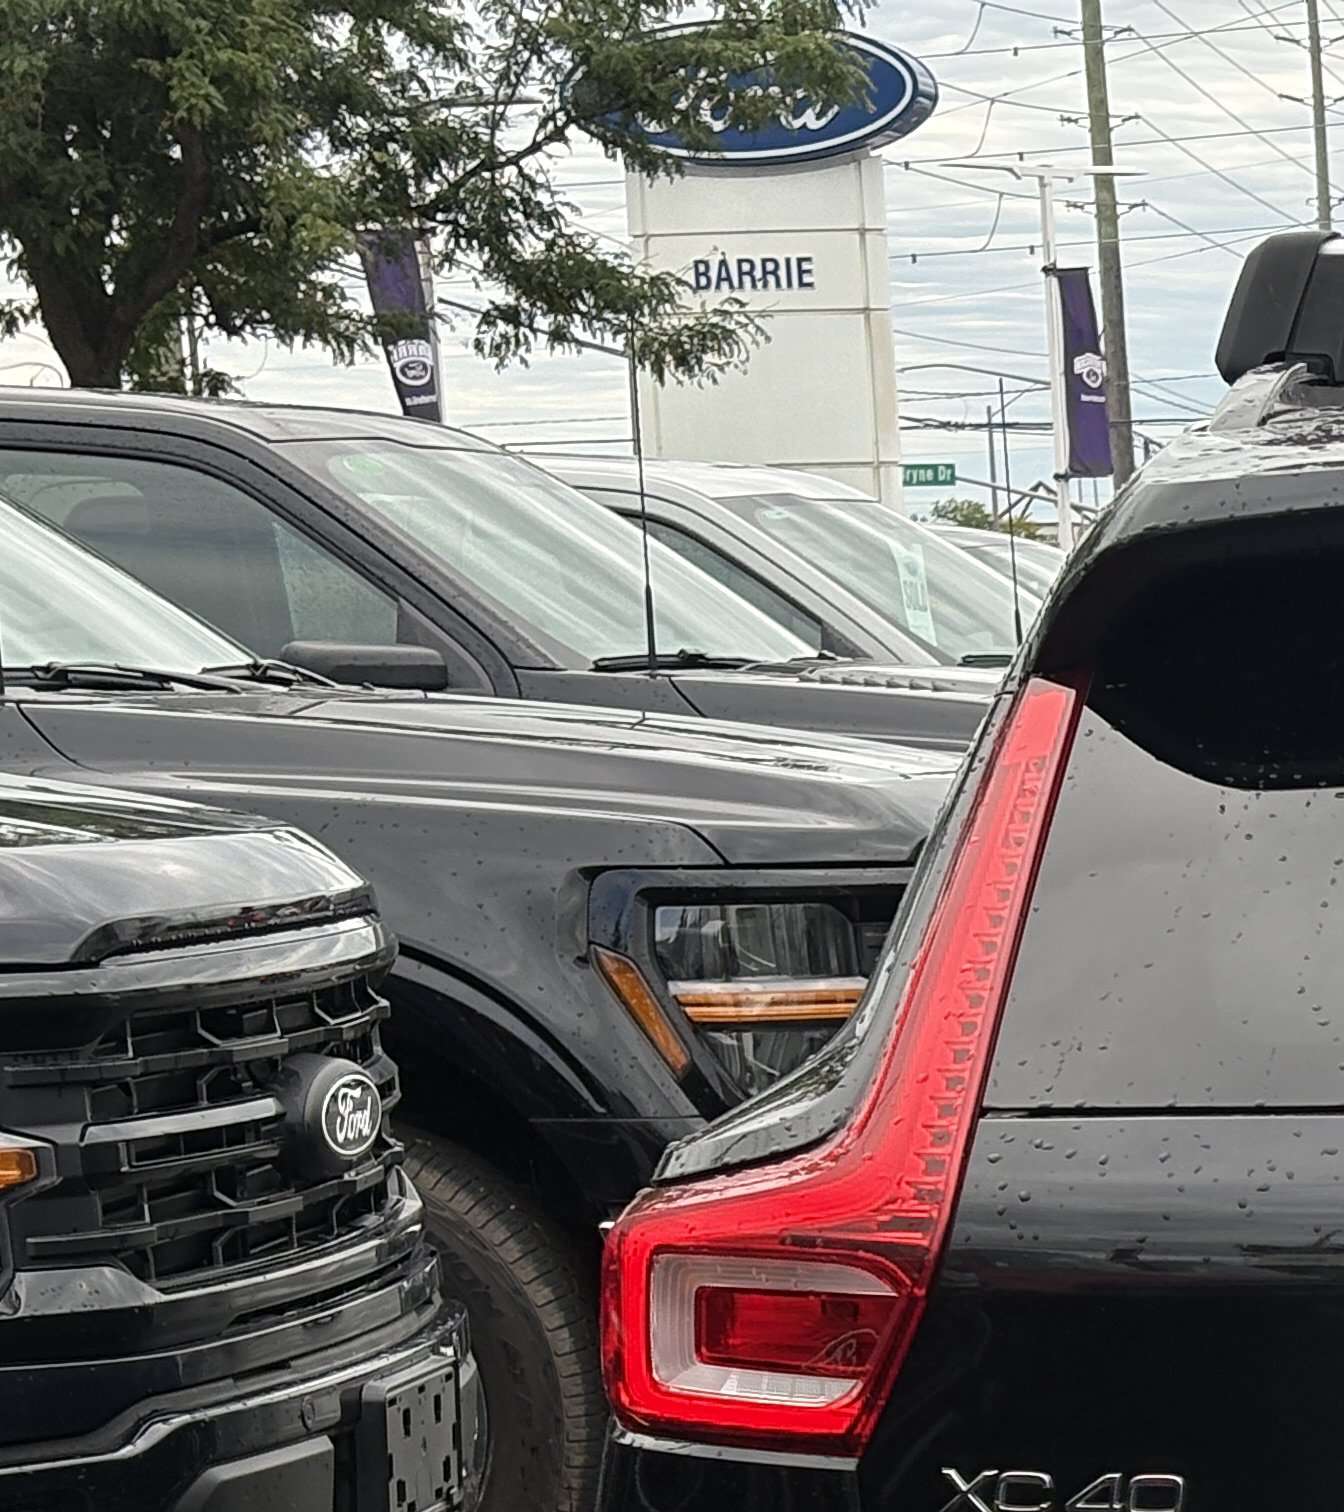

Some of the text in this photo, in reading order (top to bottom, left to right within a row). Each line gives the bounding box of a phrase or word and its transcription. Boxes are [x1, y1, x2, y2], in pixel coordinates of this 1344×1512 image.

[692, 256, 816, 292] BARRIE
[903, 465, 952, 485] ryne Dr
[336, 1086, 373, 1144] Ford
